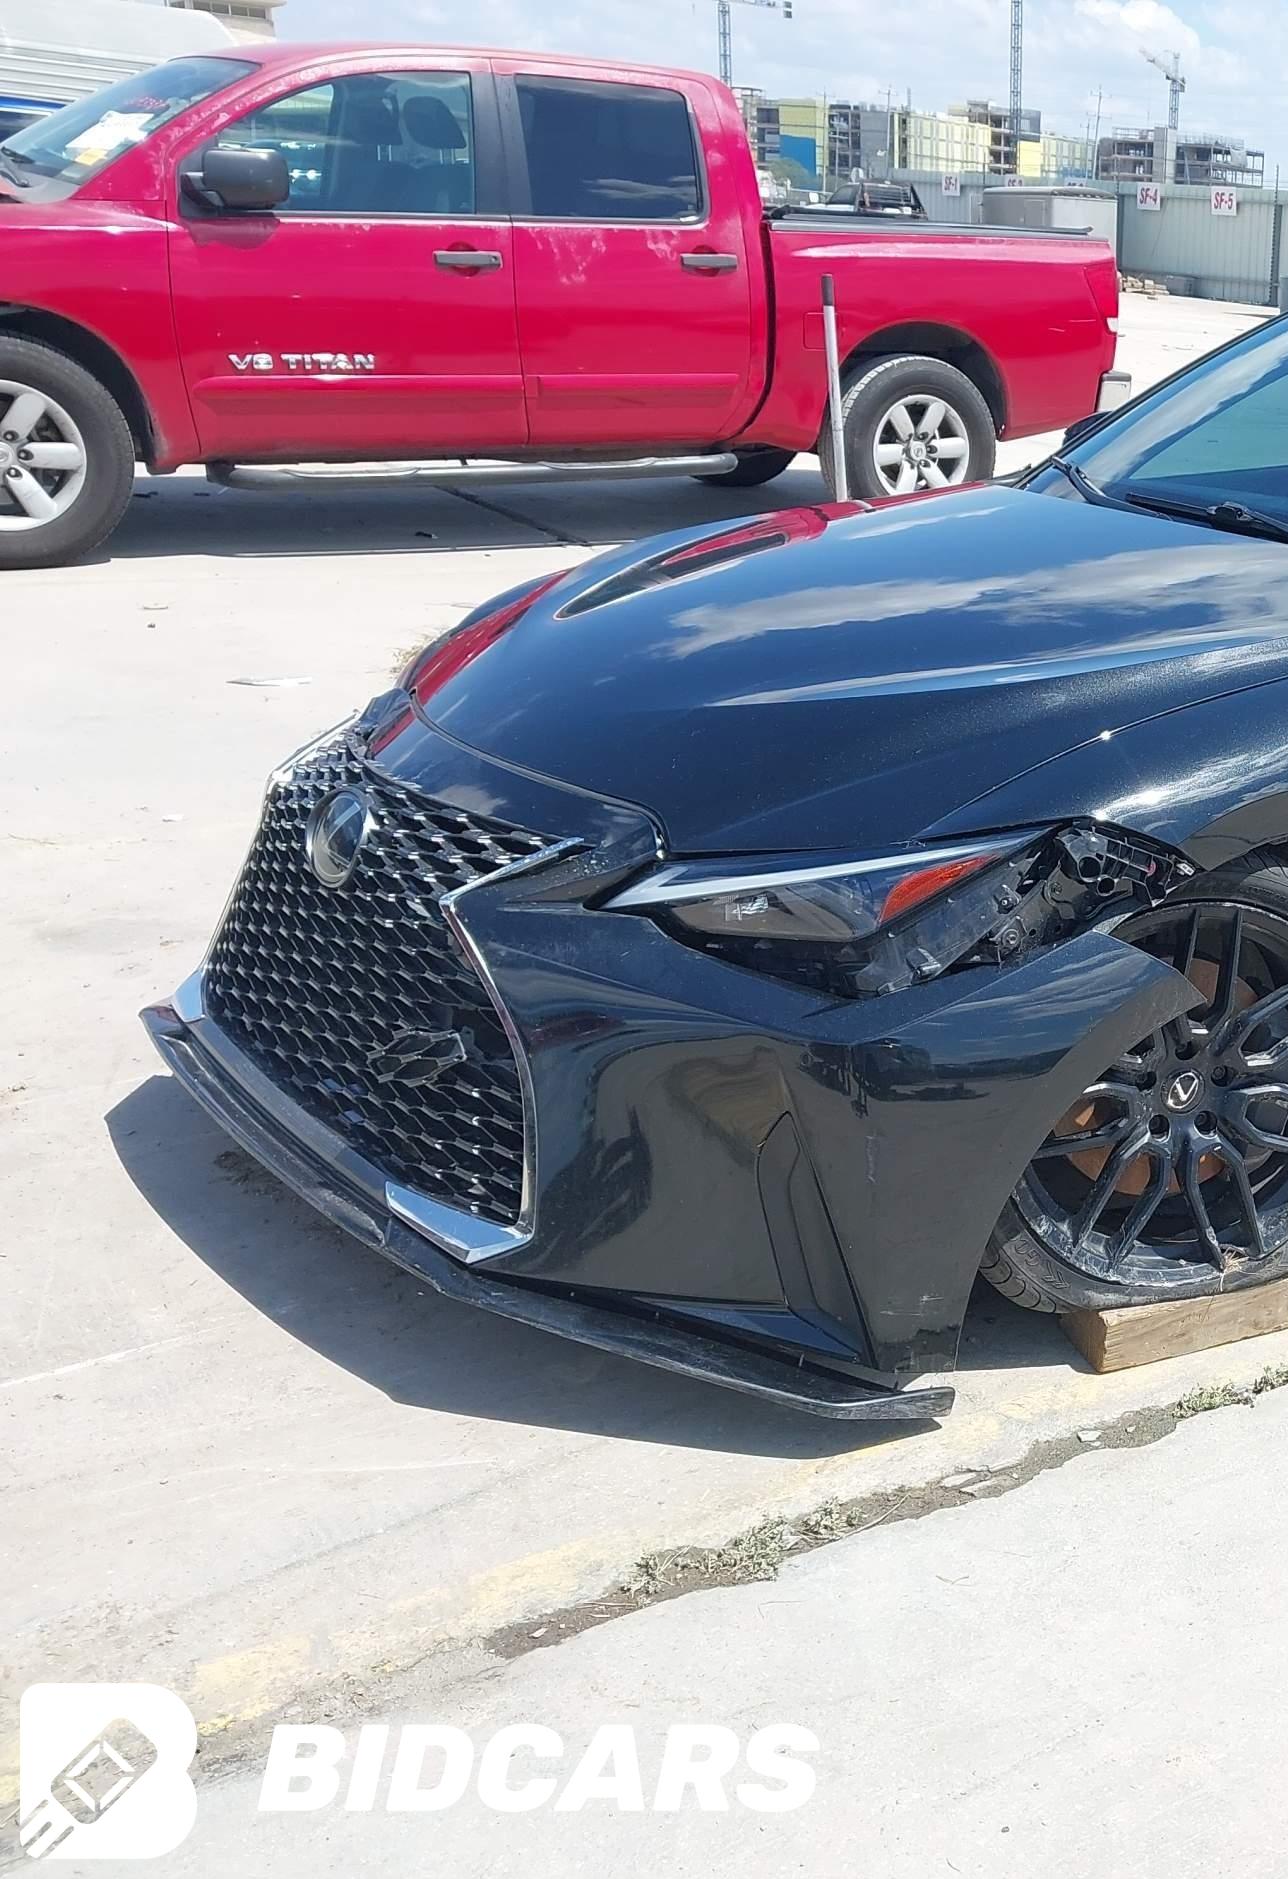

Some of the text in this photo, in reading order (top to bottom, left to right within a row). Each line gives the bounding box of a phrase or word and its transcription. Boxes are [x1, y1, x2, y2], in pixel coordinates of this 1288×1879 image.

[1139, 187, 1158, 205] SF-4
[1213, 191, 1234, 210] SF-5
[228, 353, 375, 370] V8 TITAN
